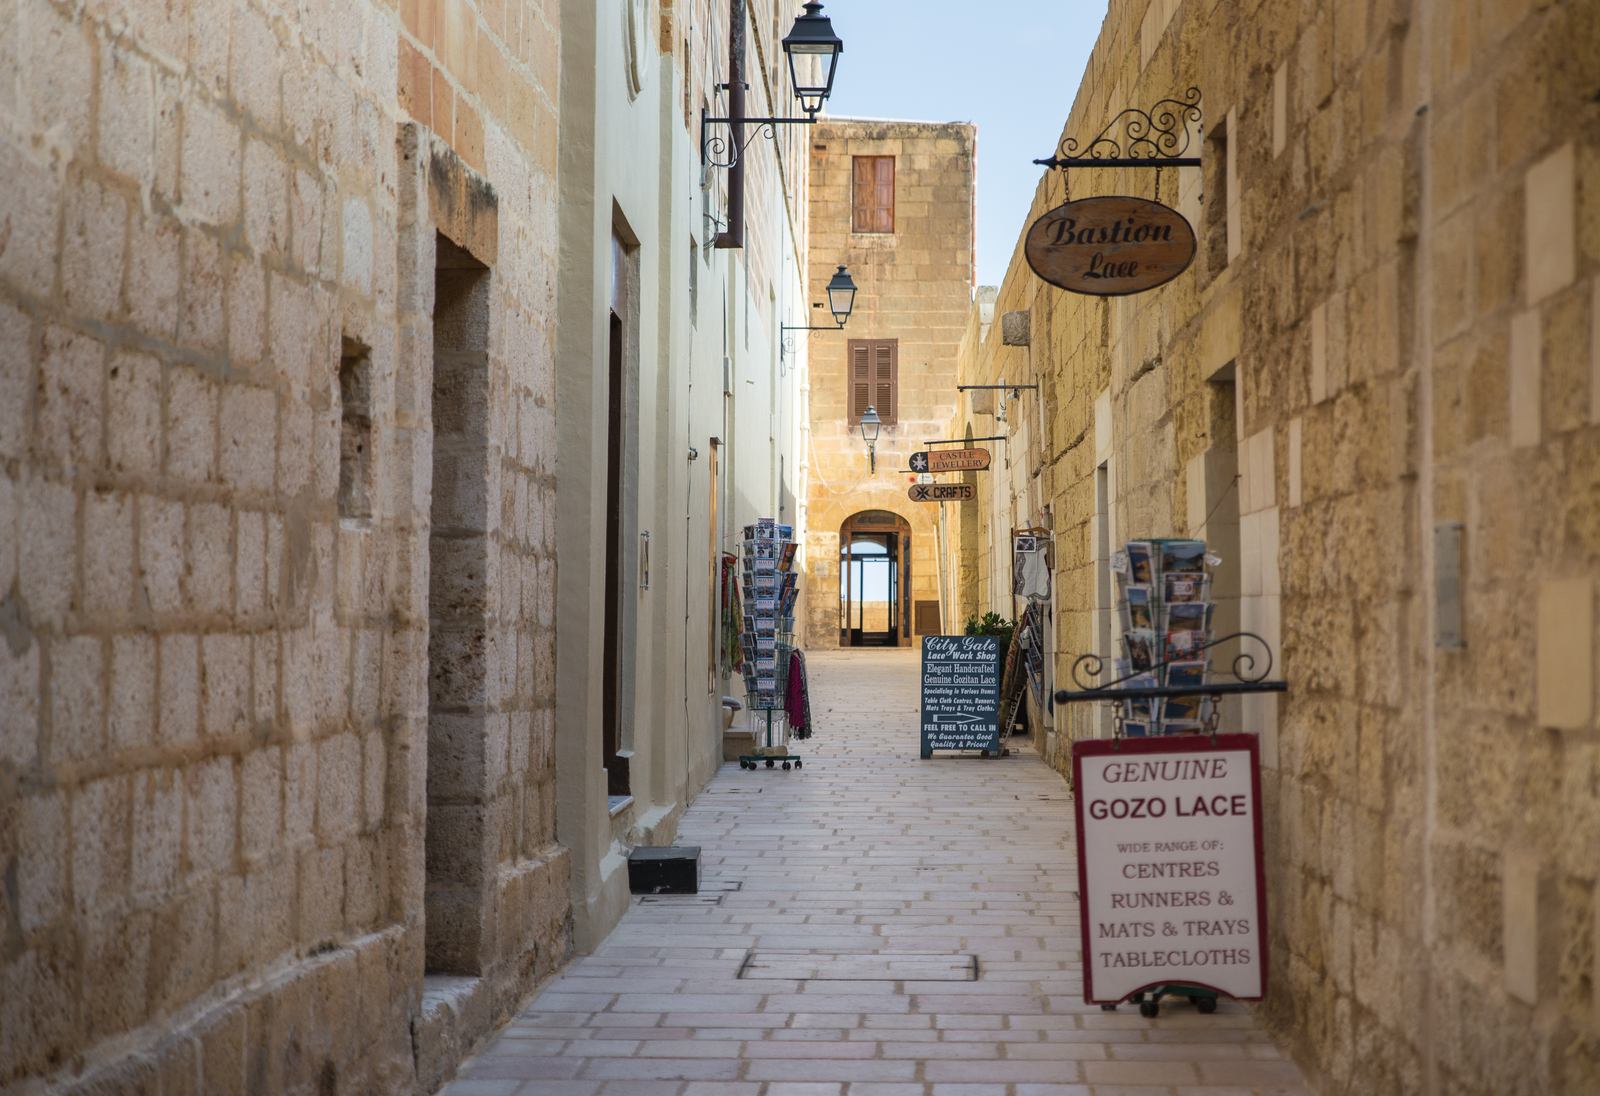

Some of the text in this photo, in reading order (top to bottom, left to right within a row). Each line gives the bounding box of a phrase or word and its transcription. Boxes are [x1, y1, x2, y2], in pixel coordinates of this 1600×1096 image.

[1046, 216, 1172, 246] Bastion
[1082, 252, 1139, 280] Lace
[930, 459, 984, 470] JEWELLERY
[933, 486, 971, 498] CRAFTS
[925, 637, 996, 656] City Gate
[976, 652, 996, 661] Shop
[927, 664, 994, 675] Elegant Handcrafted
[924, 675, 995, 684] Genuine Gozitan Lace
[930, 741, 956, 749] Quality
[1102, 758, 1228, 784] GENUINE
[1090, 795, 1247, 820] GOZO LACE
[1117, 840, 1224, 854] WIDE RANGE OF:
[1122, 861, 1220, 879] CENTRES
[1111, 890, 1234, 908] RUNNERS &
[1099, 920, 1250, 938] MATS & TRAYS
[1100, 949, 1250, 968] TABLECLOTHS
